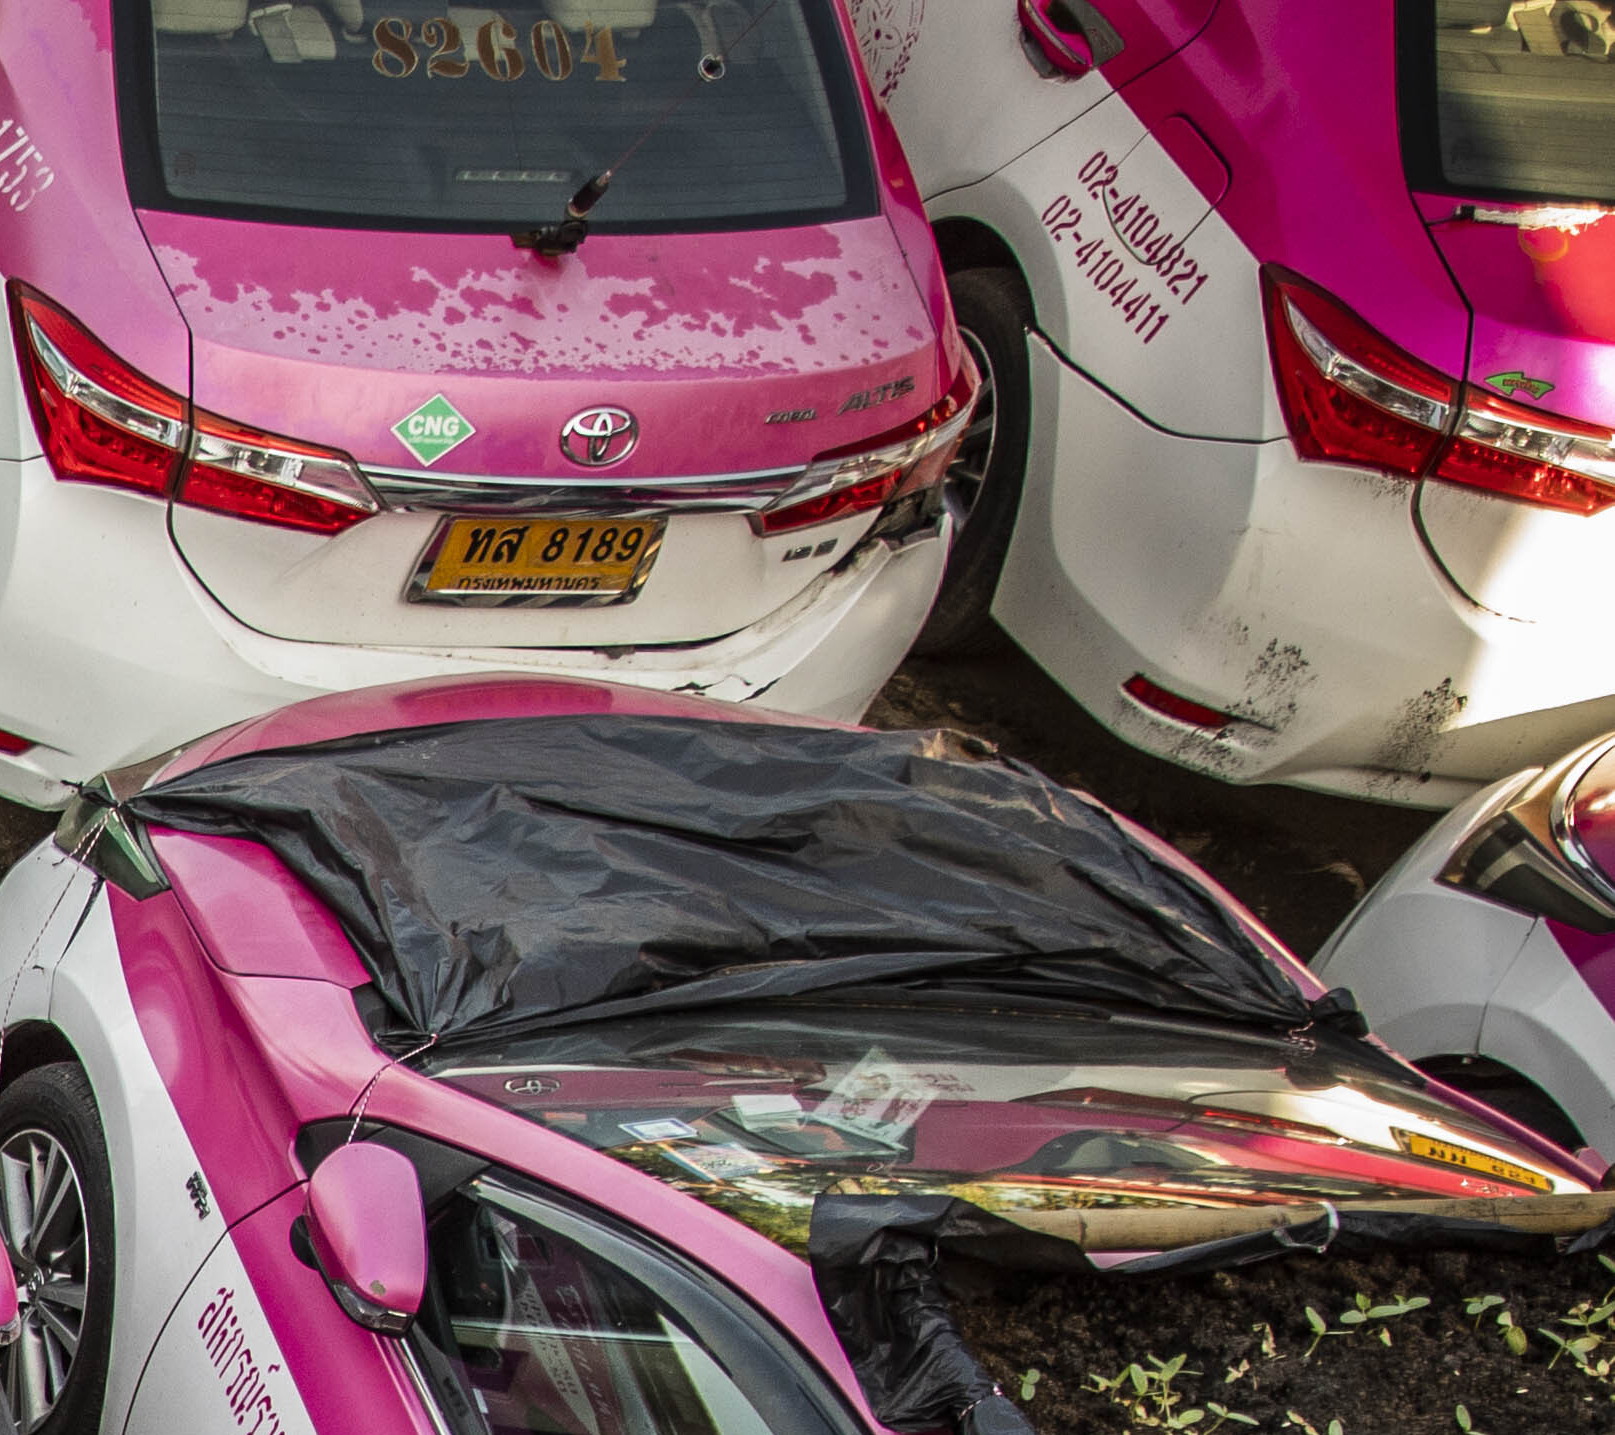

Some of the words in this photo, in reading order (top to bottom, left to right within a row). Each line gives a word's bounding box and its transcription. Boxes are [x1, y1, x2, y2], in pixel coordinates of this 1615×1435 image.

[372, 16, 627, 82] 82604
[1077, 151, 1209, 305] 02-4104821
[1041, 195, 1170, 345] 02-4104411
[407, 415, 460, 437] CNG
[462, 525, 530, 563] ทส
[541, 526, 644, 563] 8189
